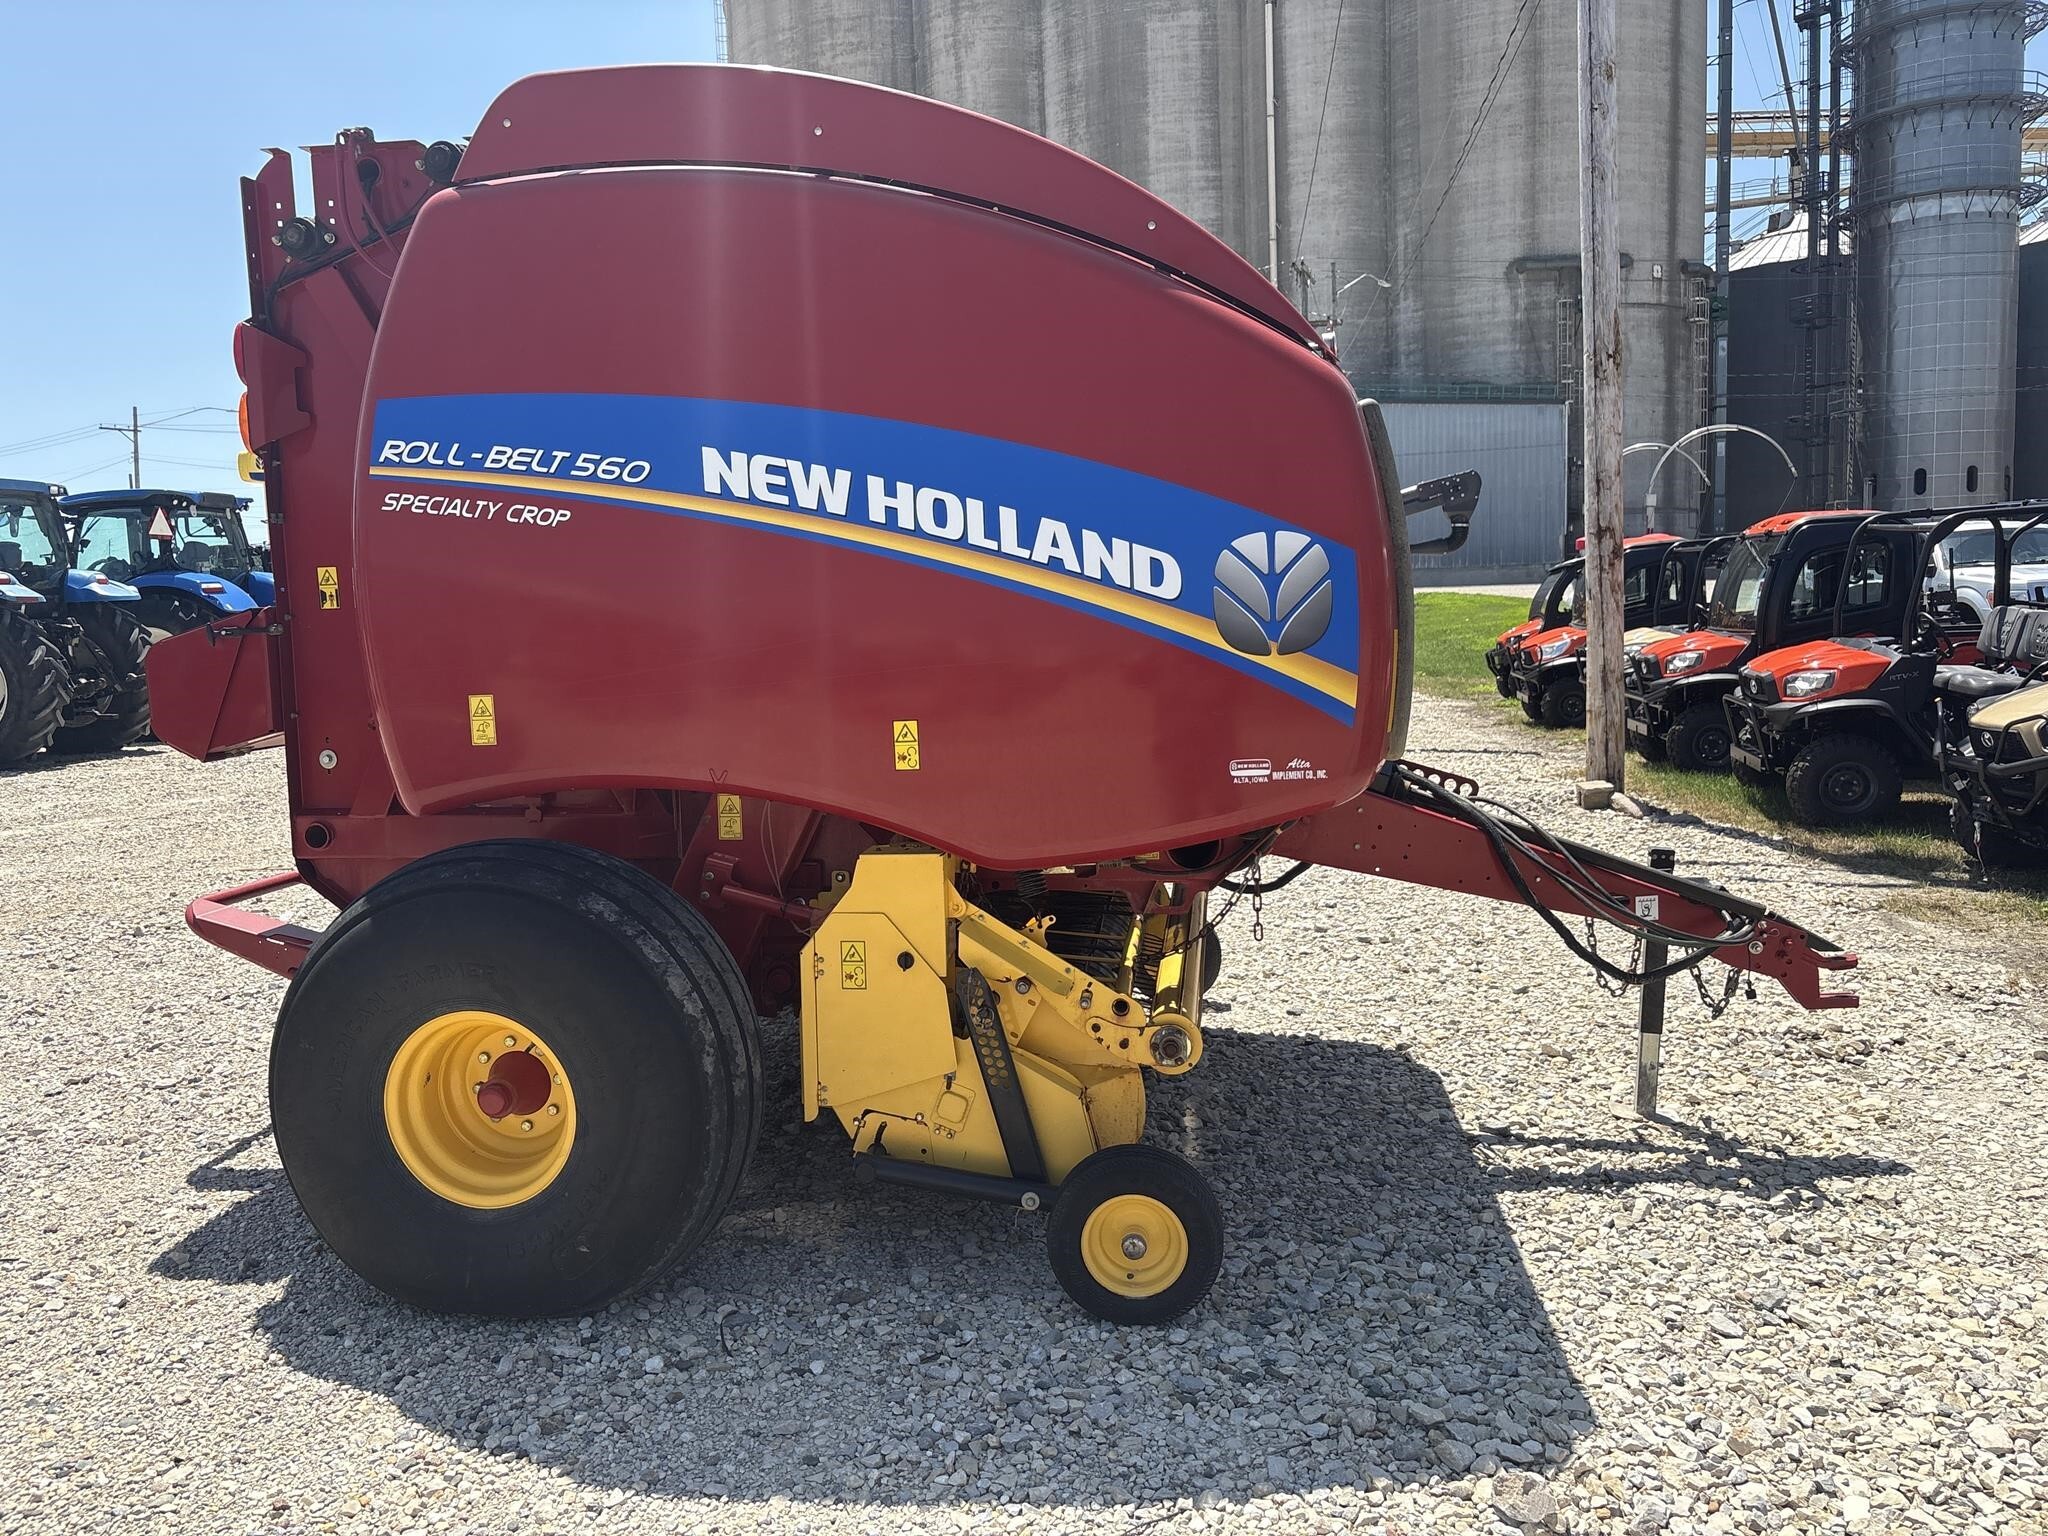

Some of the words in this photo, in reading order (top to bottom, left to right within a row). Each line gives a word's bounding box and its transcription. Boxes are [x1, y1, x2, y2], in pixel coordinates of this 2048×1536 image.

[378, 439, 570, 474] ROLL-BELT
[570, 452, 652, 484] 560
[380, 493, 504, 521] SPECIALTY
[506, 504, 572, 528] CROP
[702, 446, 851, 516] NEW
[867, 474, 1183, 601] HOLLAND
[1272, 770, 1304, 780] IMPLEMENT
[1286, 758, 1311, 769] Alta
